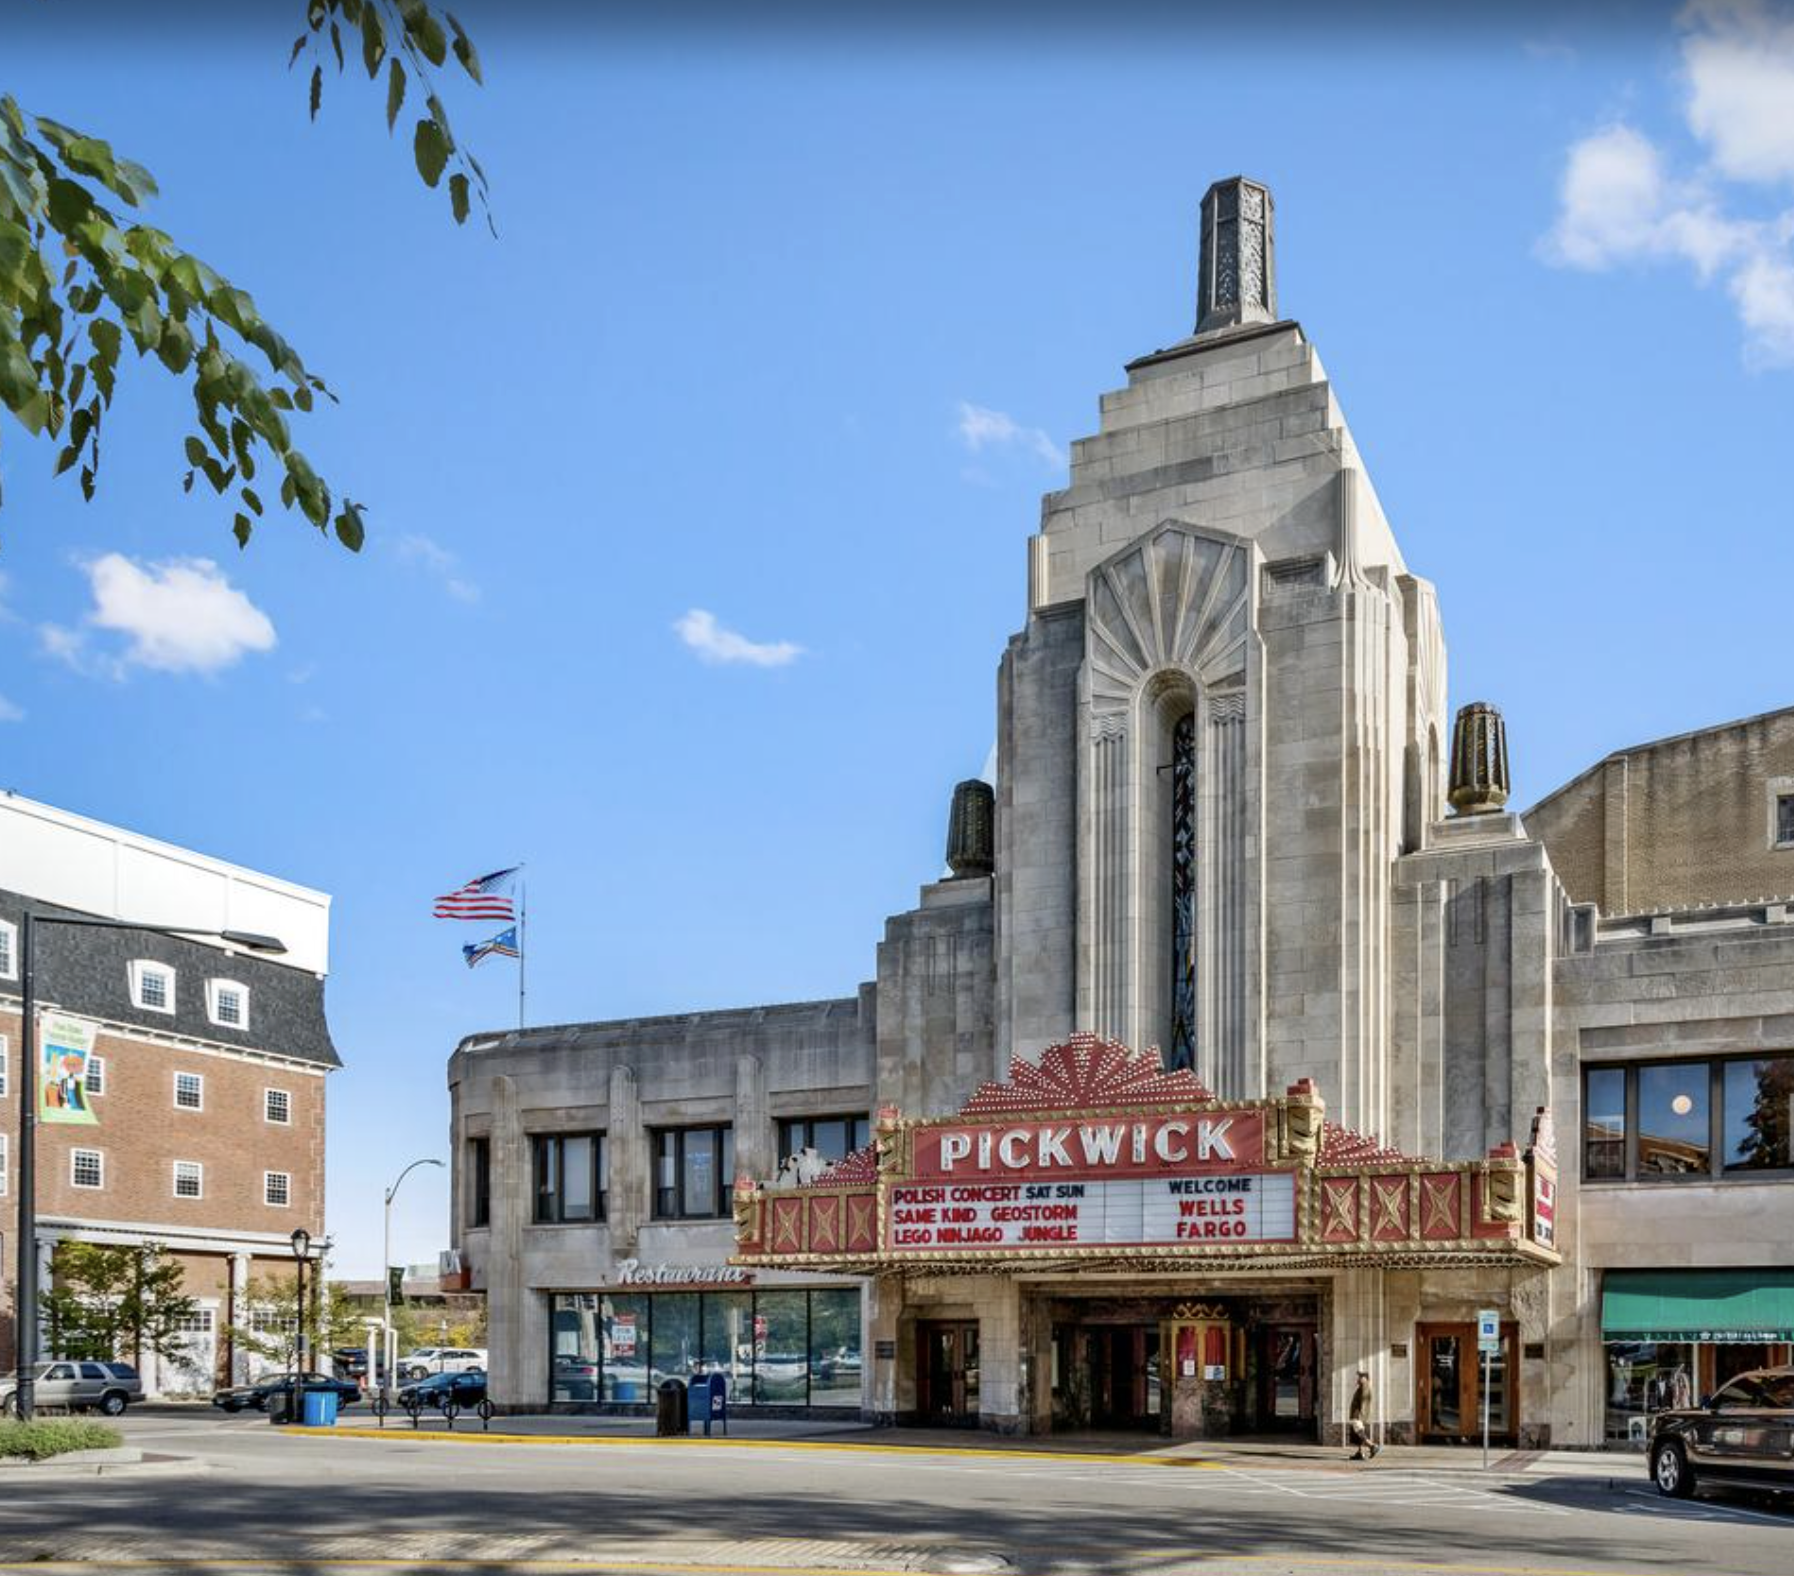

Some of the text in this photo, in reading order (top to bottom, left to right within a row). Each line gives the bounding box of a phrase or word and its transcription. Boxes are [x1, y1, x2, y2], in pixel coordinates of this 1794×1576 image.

[940, 1118, 1235, 1171] PICKWICK
[893, 1184, 1084, 1205] POLISH CONCERT SAT SUN
[1169, 1178, 1252, 1194] WELCOME
[894, 1205, 1078, 1224] SAME KIND GEOSTORM
[1179, 1199, 1244, 1216] WELLS
[894, 1225, 1078, 1245] LEGO NINJAGO JUNGLE
[1176, 1221, 1246, 1238] FARGO
